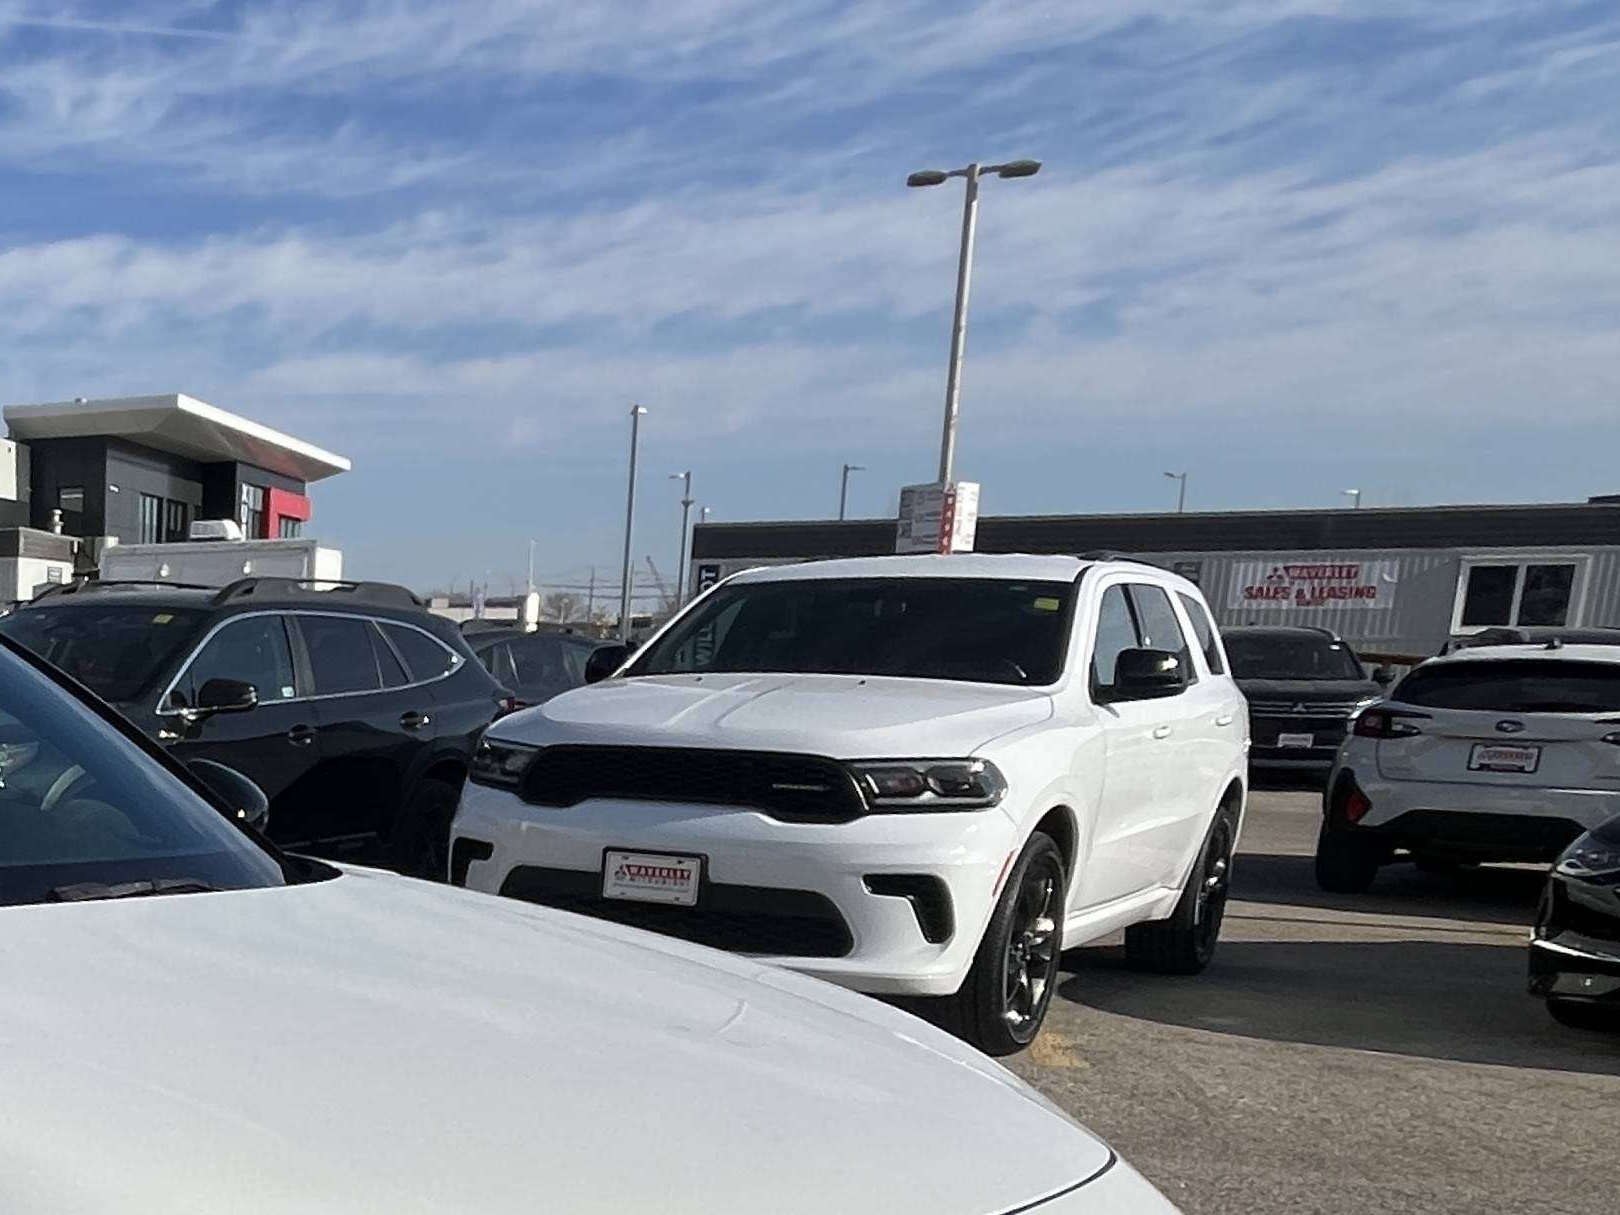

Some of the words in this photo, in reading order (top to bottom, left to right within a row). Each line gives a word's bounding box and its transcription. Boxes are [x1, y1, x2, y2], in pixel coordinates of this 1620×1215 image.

[1243, 586, 1291, 600] SALES
[1294, 587, 1307, 600] &
[1310, 585, 1377, 599] LEASING
[629, 866, 691, 880] WAVERLEY
